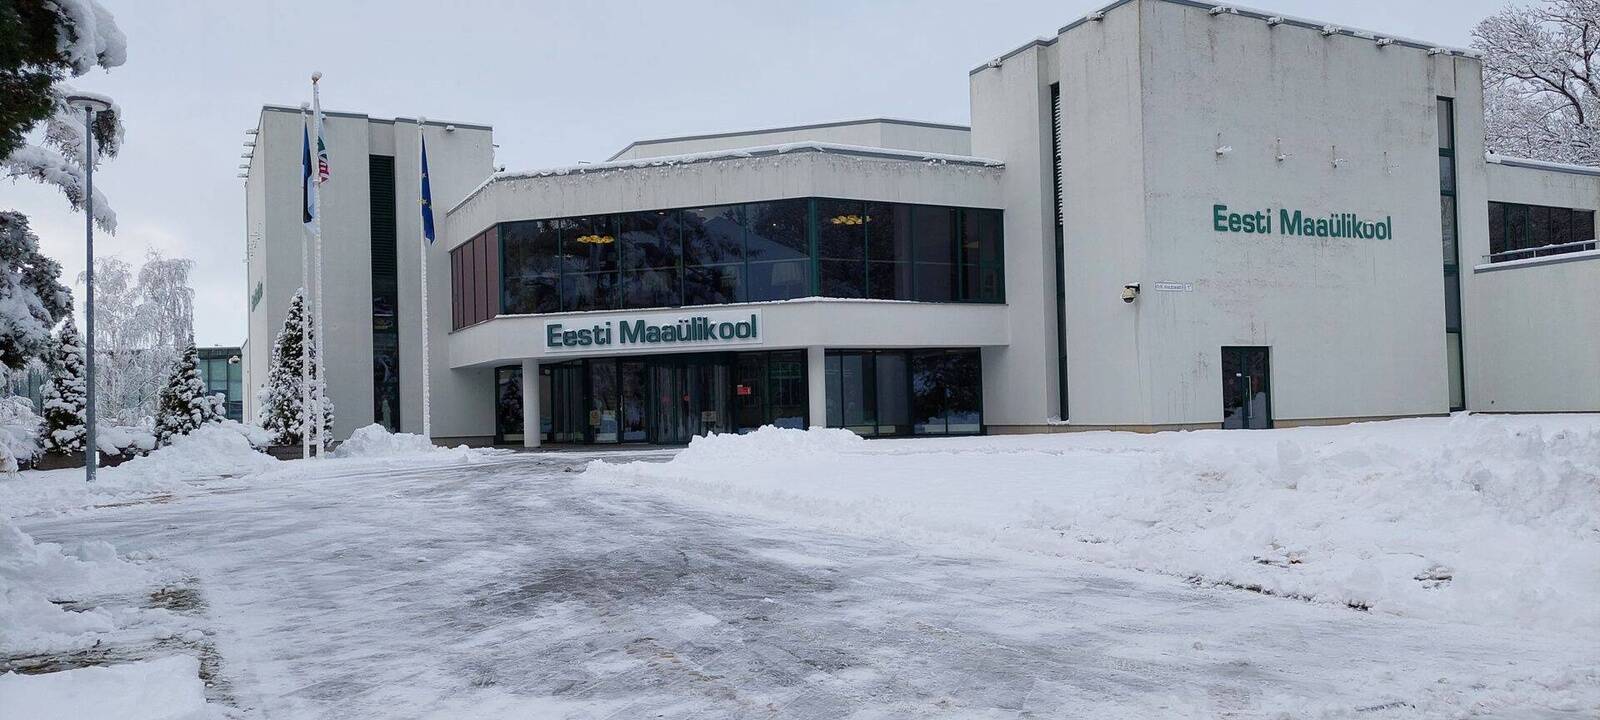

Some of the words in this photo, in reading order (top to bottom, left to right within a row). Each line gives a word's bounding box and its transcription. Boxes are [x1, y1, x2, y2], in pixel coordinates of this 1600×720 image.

[1213, 204, 1271, 234] Eesti
[1280, 208, 1392, 240] Maaülikool
[546, 321, 611, 347] Eesti
[619, 314, 757, 343] Maaülikool
